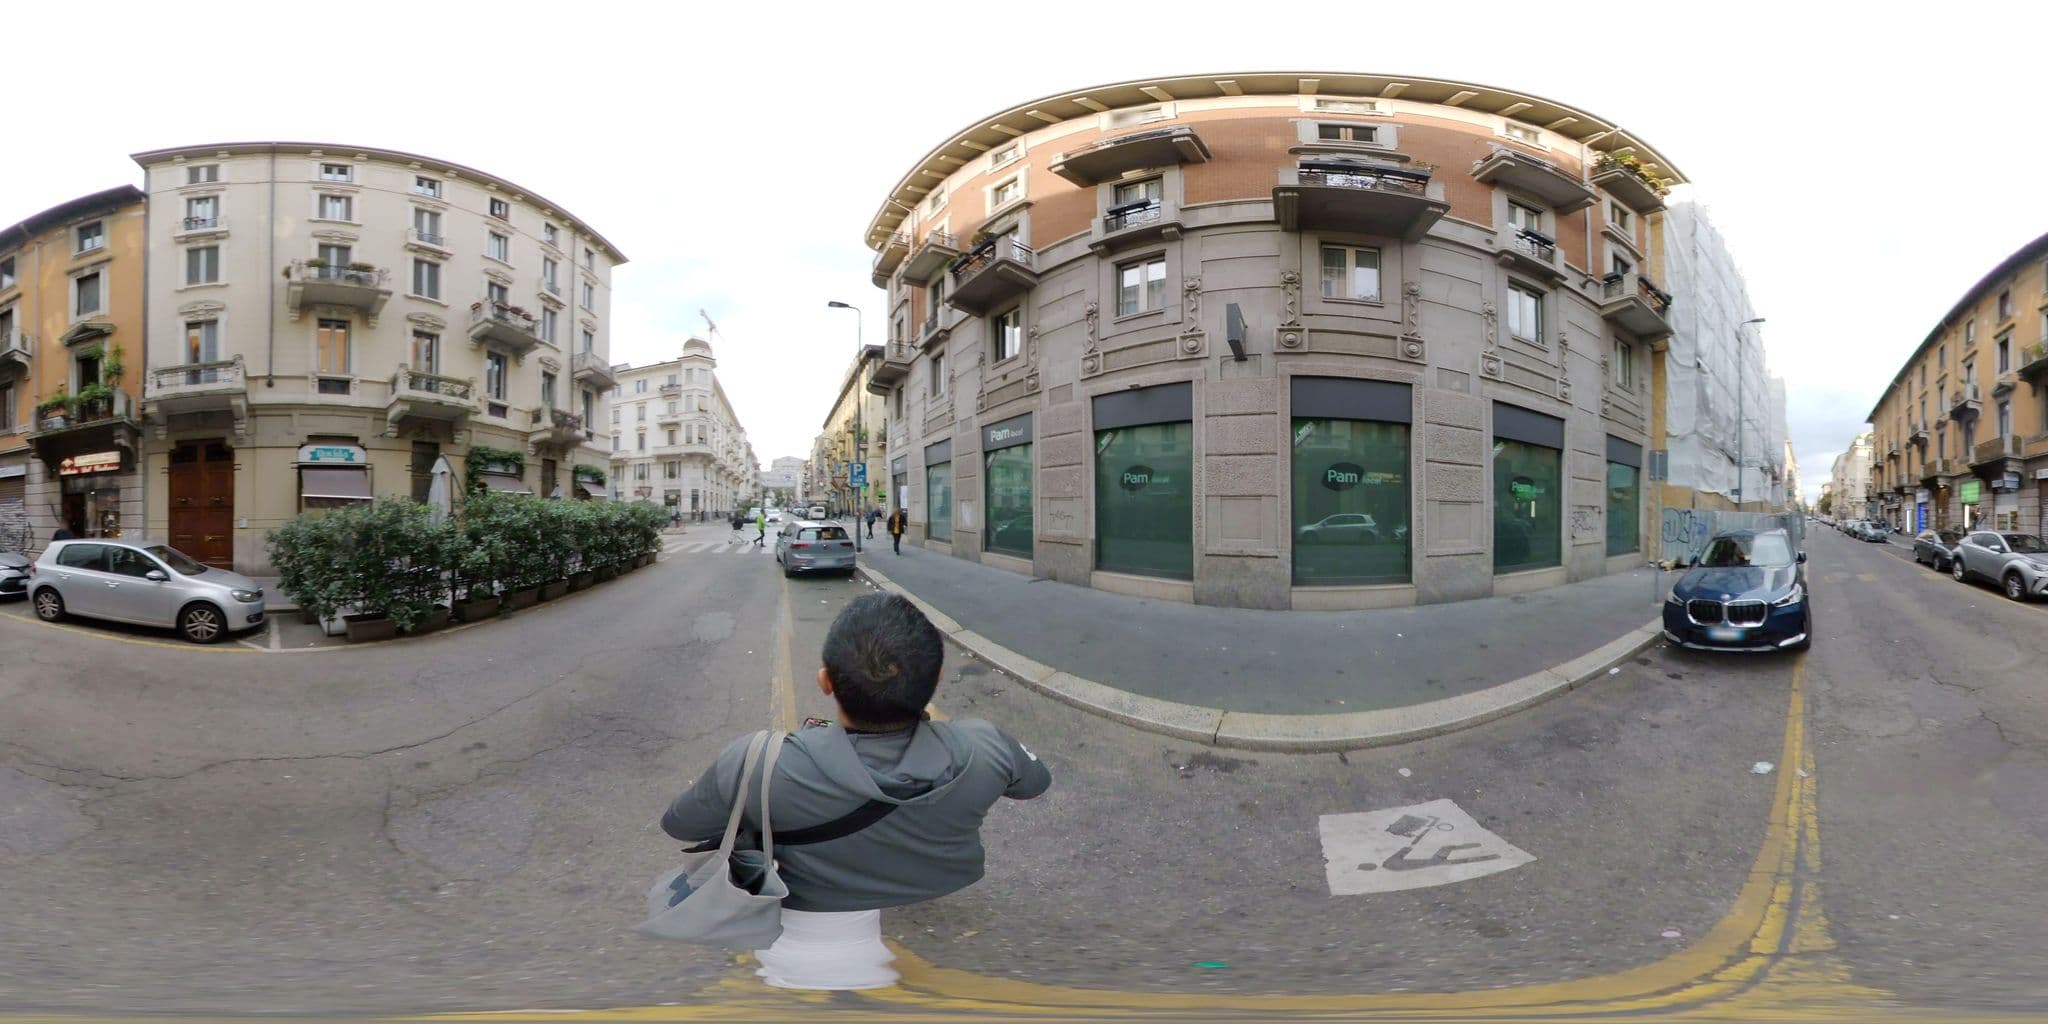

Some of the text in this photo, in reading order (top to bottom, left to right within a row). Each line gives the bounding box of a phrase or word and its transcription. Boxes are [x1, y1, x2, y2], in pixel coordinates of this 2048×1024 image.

[990, 428, 1010, 443] Pam
[853, 464, 863, 475] P
[1124, 472, 1148, 484] Pam
[1327, 470, 1358, 483] Pam
